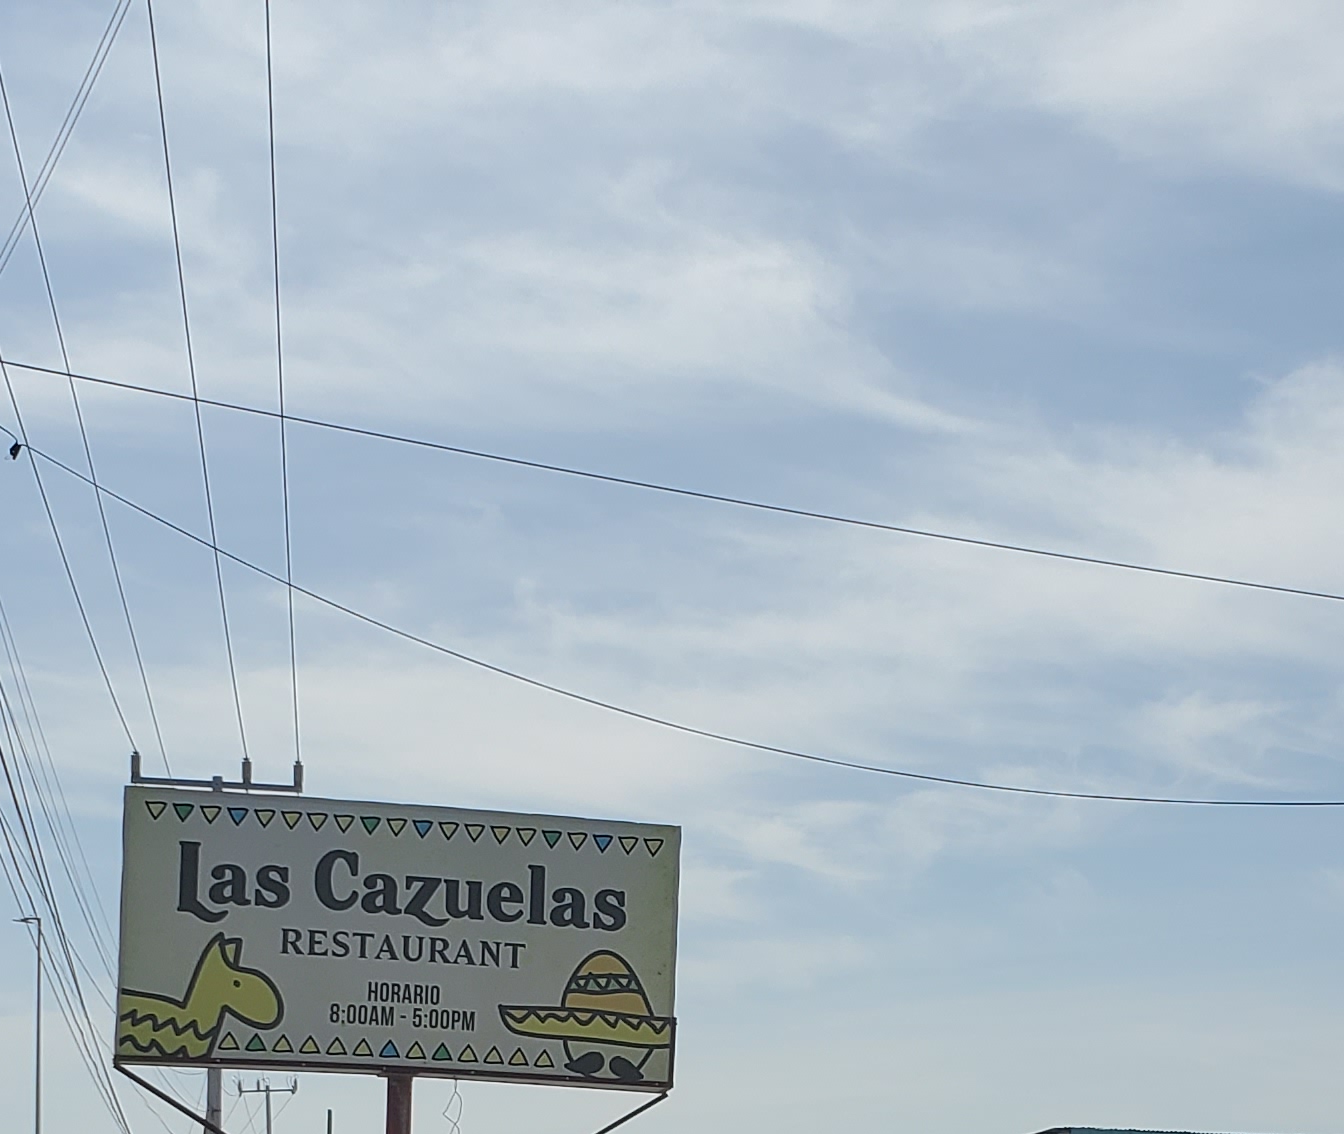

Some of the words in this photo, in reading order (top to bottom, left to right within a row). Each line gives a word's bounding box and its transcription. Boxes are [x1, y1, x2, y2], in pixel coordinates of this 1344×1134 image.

[177, 840, 290, 923] Las
[314, 849, 628, 932] Cazuelas
[280, 928, 527, 969] RESTAURANT
[367, 981, 441, 1005] HORARIO
[329, 1005, 395, 1028] 8:00AM
[412, 1008, 476, 1032] 5:00PM
